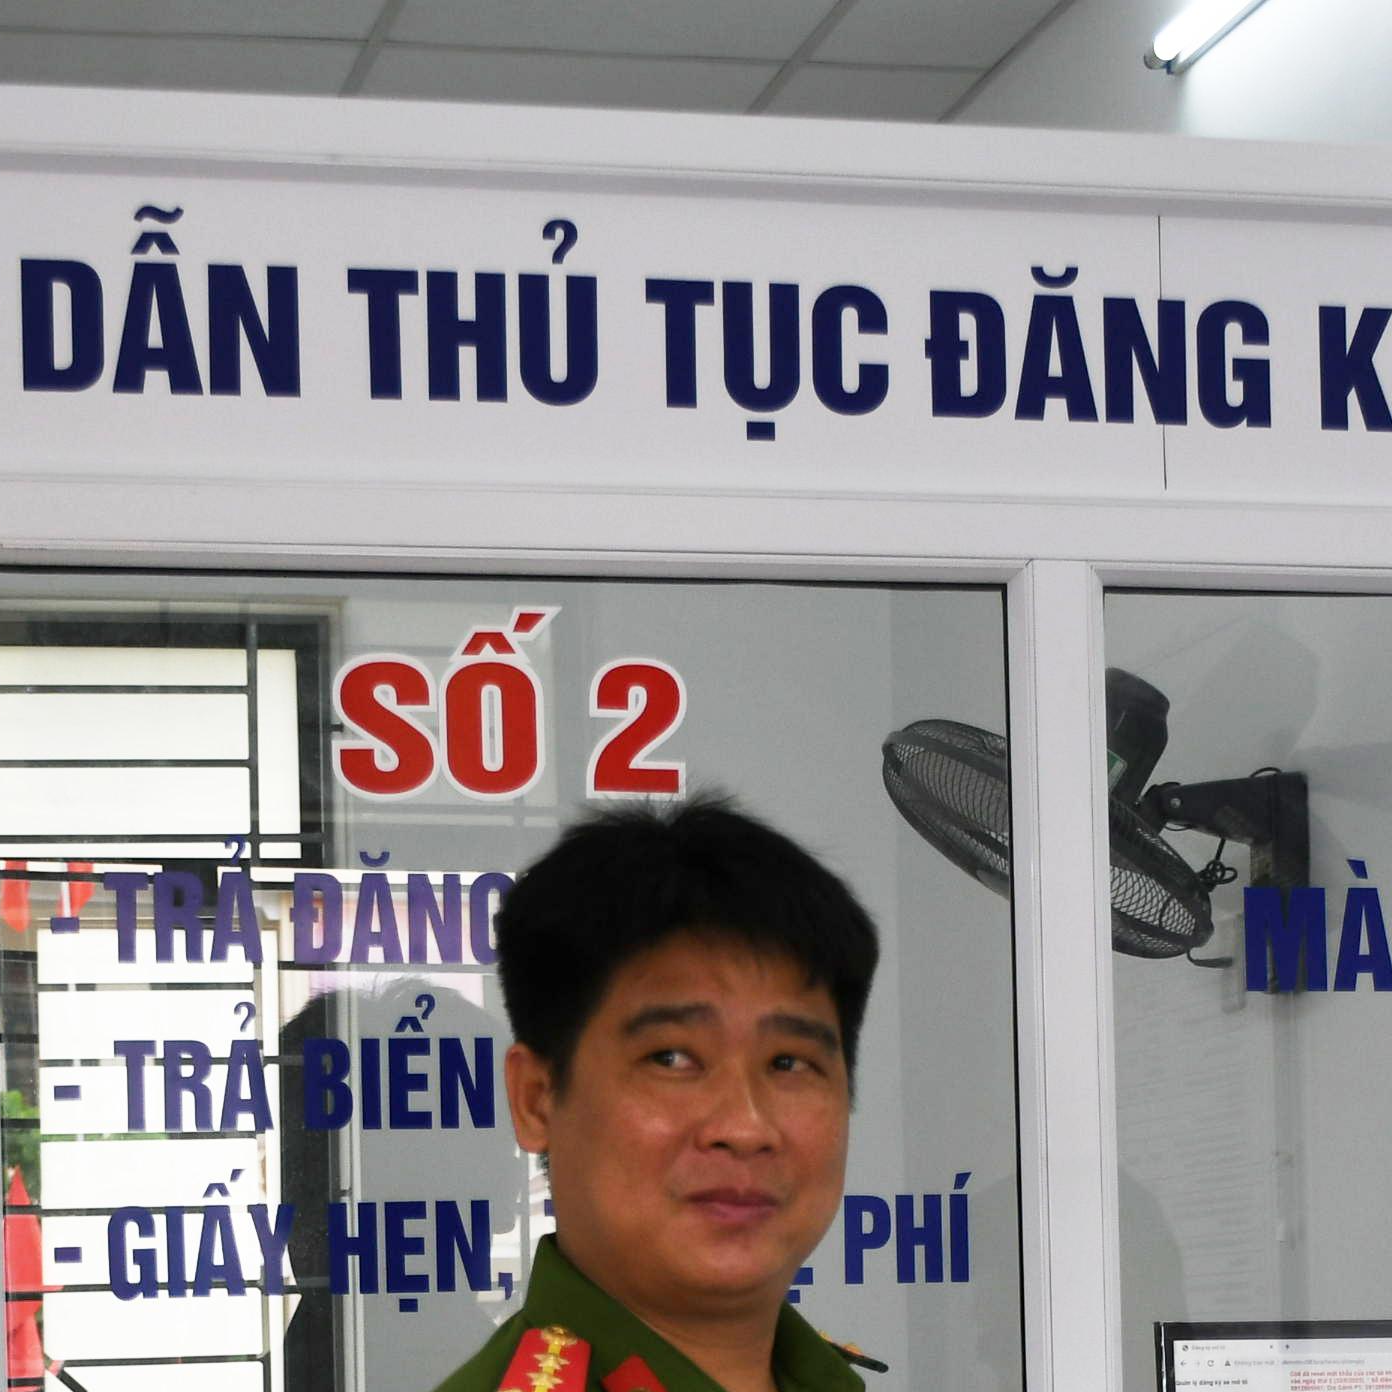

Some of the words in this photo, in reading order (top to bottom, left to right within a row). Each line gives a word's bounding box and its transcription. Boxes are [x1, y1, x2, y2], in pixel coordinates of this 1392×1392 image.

[19, 205, 301, 398] DẪN
[347, 219, 599, 407] THỦ
[645, 278, 889, 442] TỤC
[924, 266, 1271, 430] ĐĂNG
[333, 607, 558, 796] SỐ
[588, 660, 685, 797] 2
[104, 835, 264, 965] TRẢ
[114, 1002, 273, 1131] TRẢ
[303, 994, 496, 1130] BIỂN
[107, 1168, 294, 1300] GIẤY
[329, 1198, 513, 1312] HẸN,
[844, 1172, 971, 1285] PHÍ
